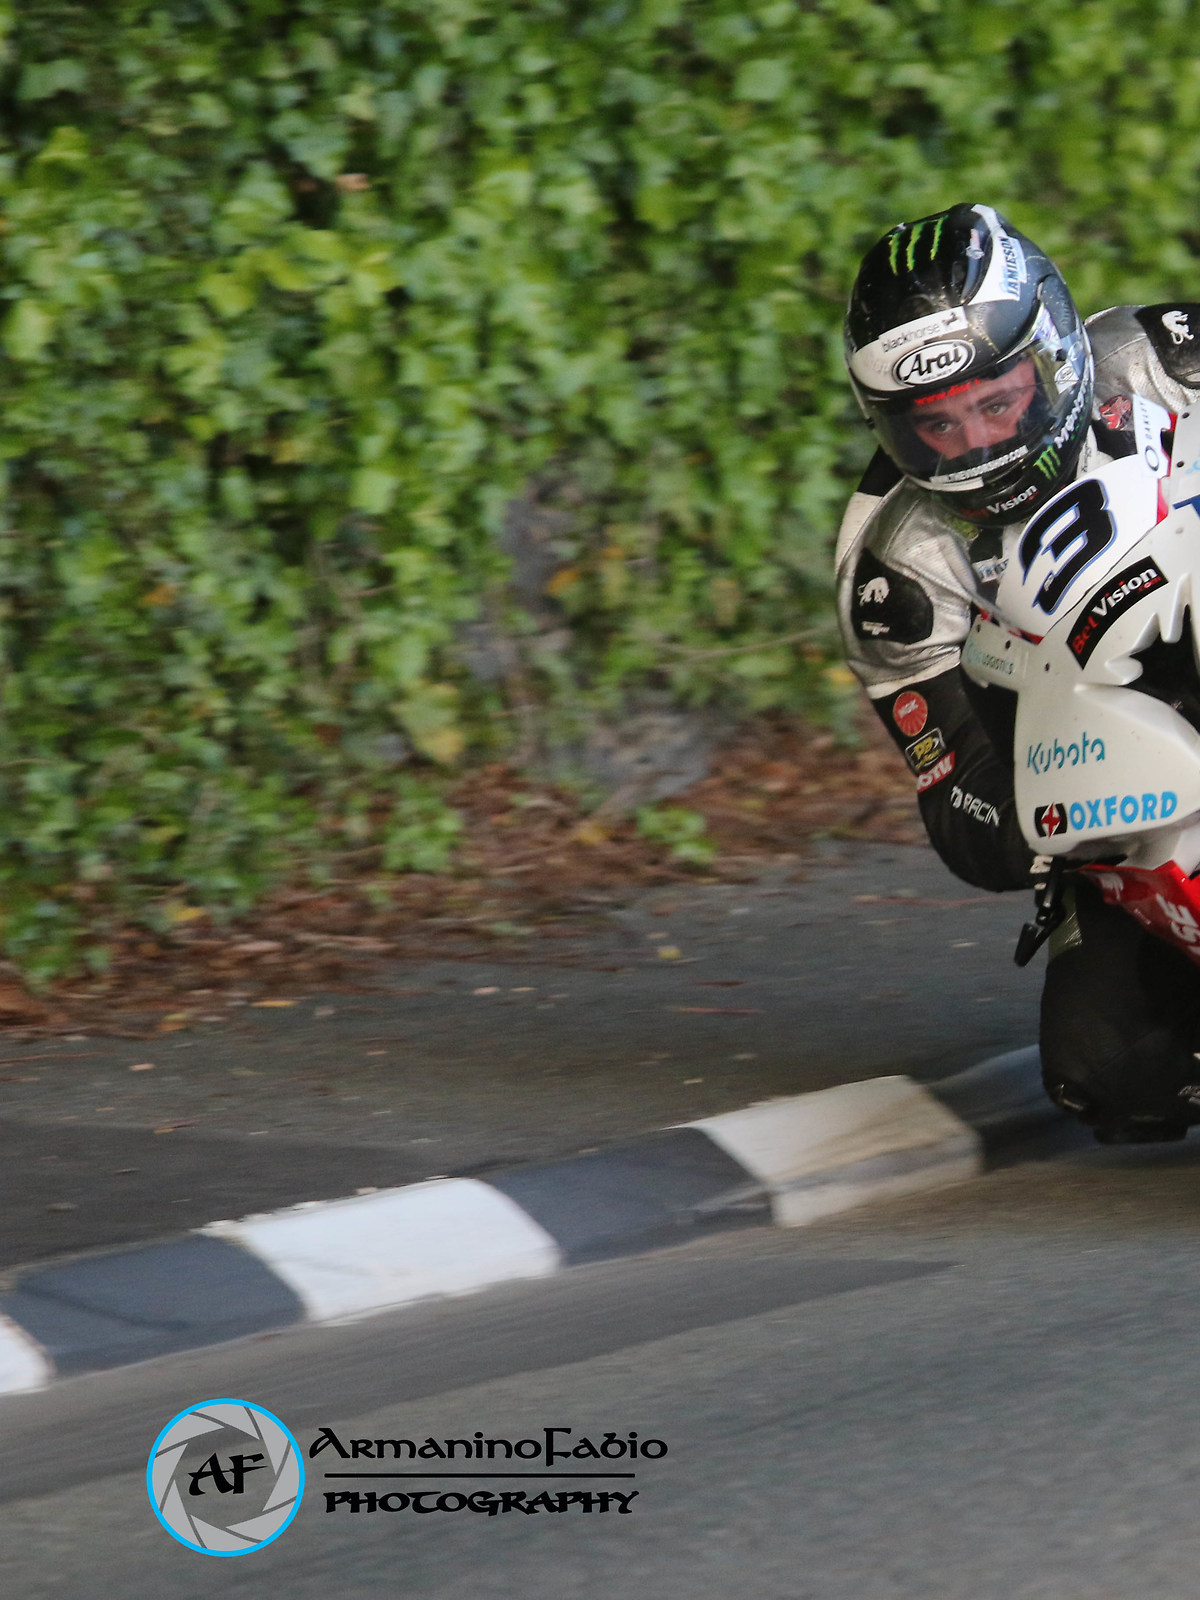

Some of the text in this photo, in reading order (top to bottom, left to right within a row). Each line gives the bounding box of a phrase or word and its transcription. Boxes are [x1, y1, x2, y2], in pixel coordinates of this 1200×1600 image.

[881, 323, 940, 353] blackhorse
[901, 343, 963, 381] Arai
[986, 485, 1038, 514] Vision
[1018, 478, 1119, 615] 3
[1027, 731, 1105, 775] Kubota
[1069, 791, 1178, 831] OXFORD
